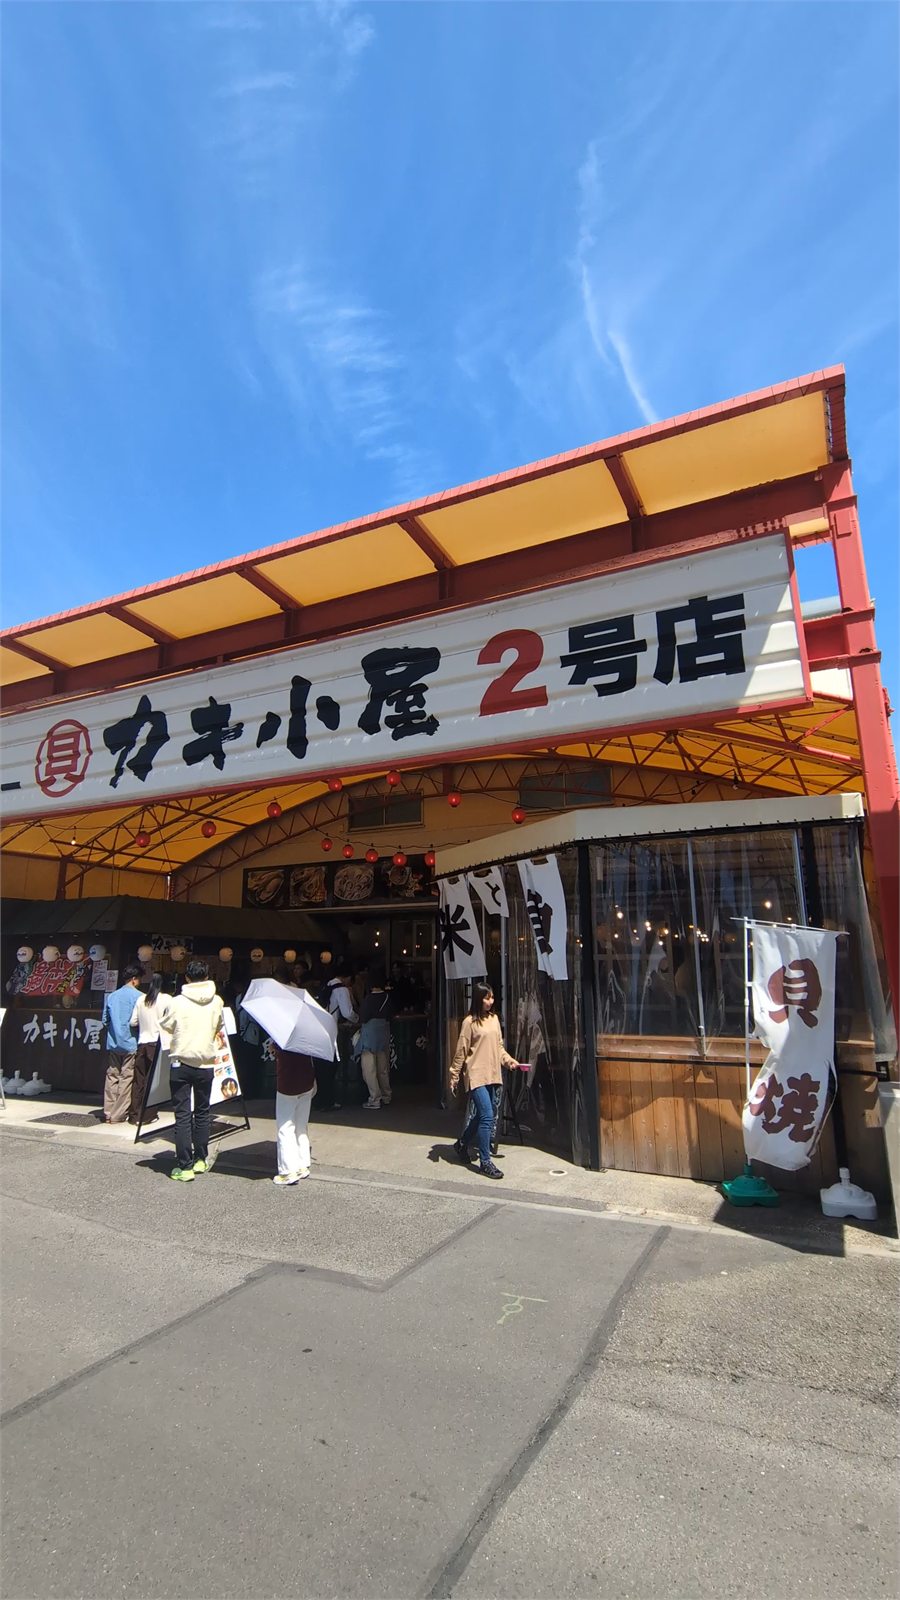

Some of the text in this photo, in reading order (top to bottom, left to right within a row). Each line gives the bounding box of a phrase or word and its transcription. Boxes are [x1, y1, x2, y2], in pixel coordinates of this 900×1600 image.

[103, 647, 441, 788] カキ小屋
[477, 593, 747, 716] 2号店
[440, 904, 475, 962] 米
[23, 1013, 103, 1050] カキ小屋
[749, 957, 823, 1142] 貝焼
